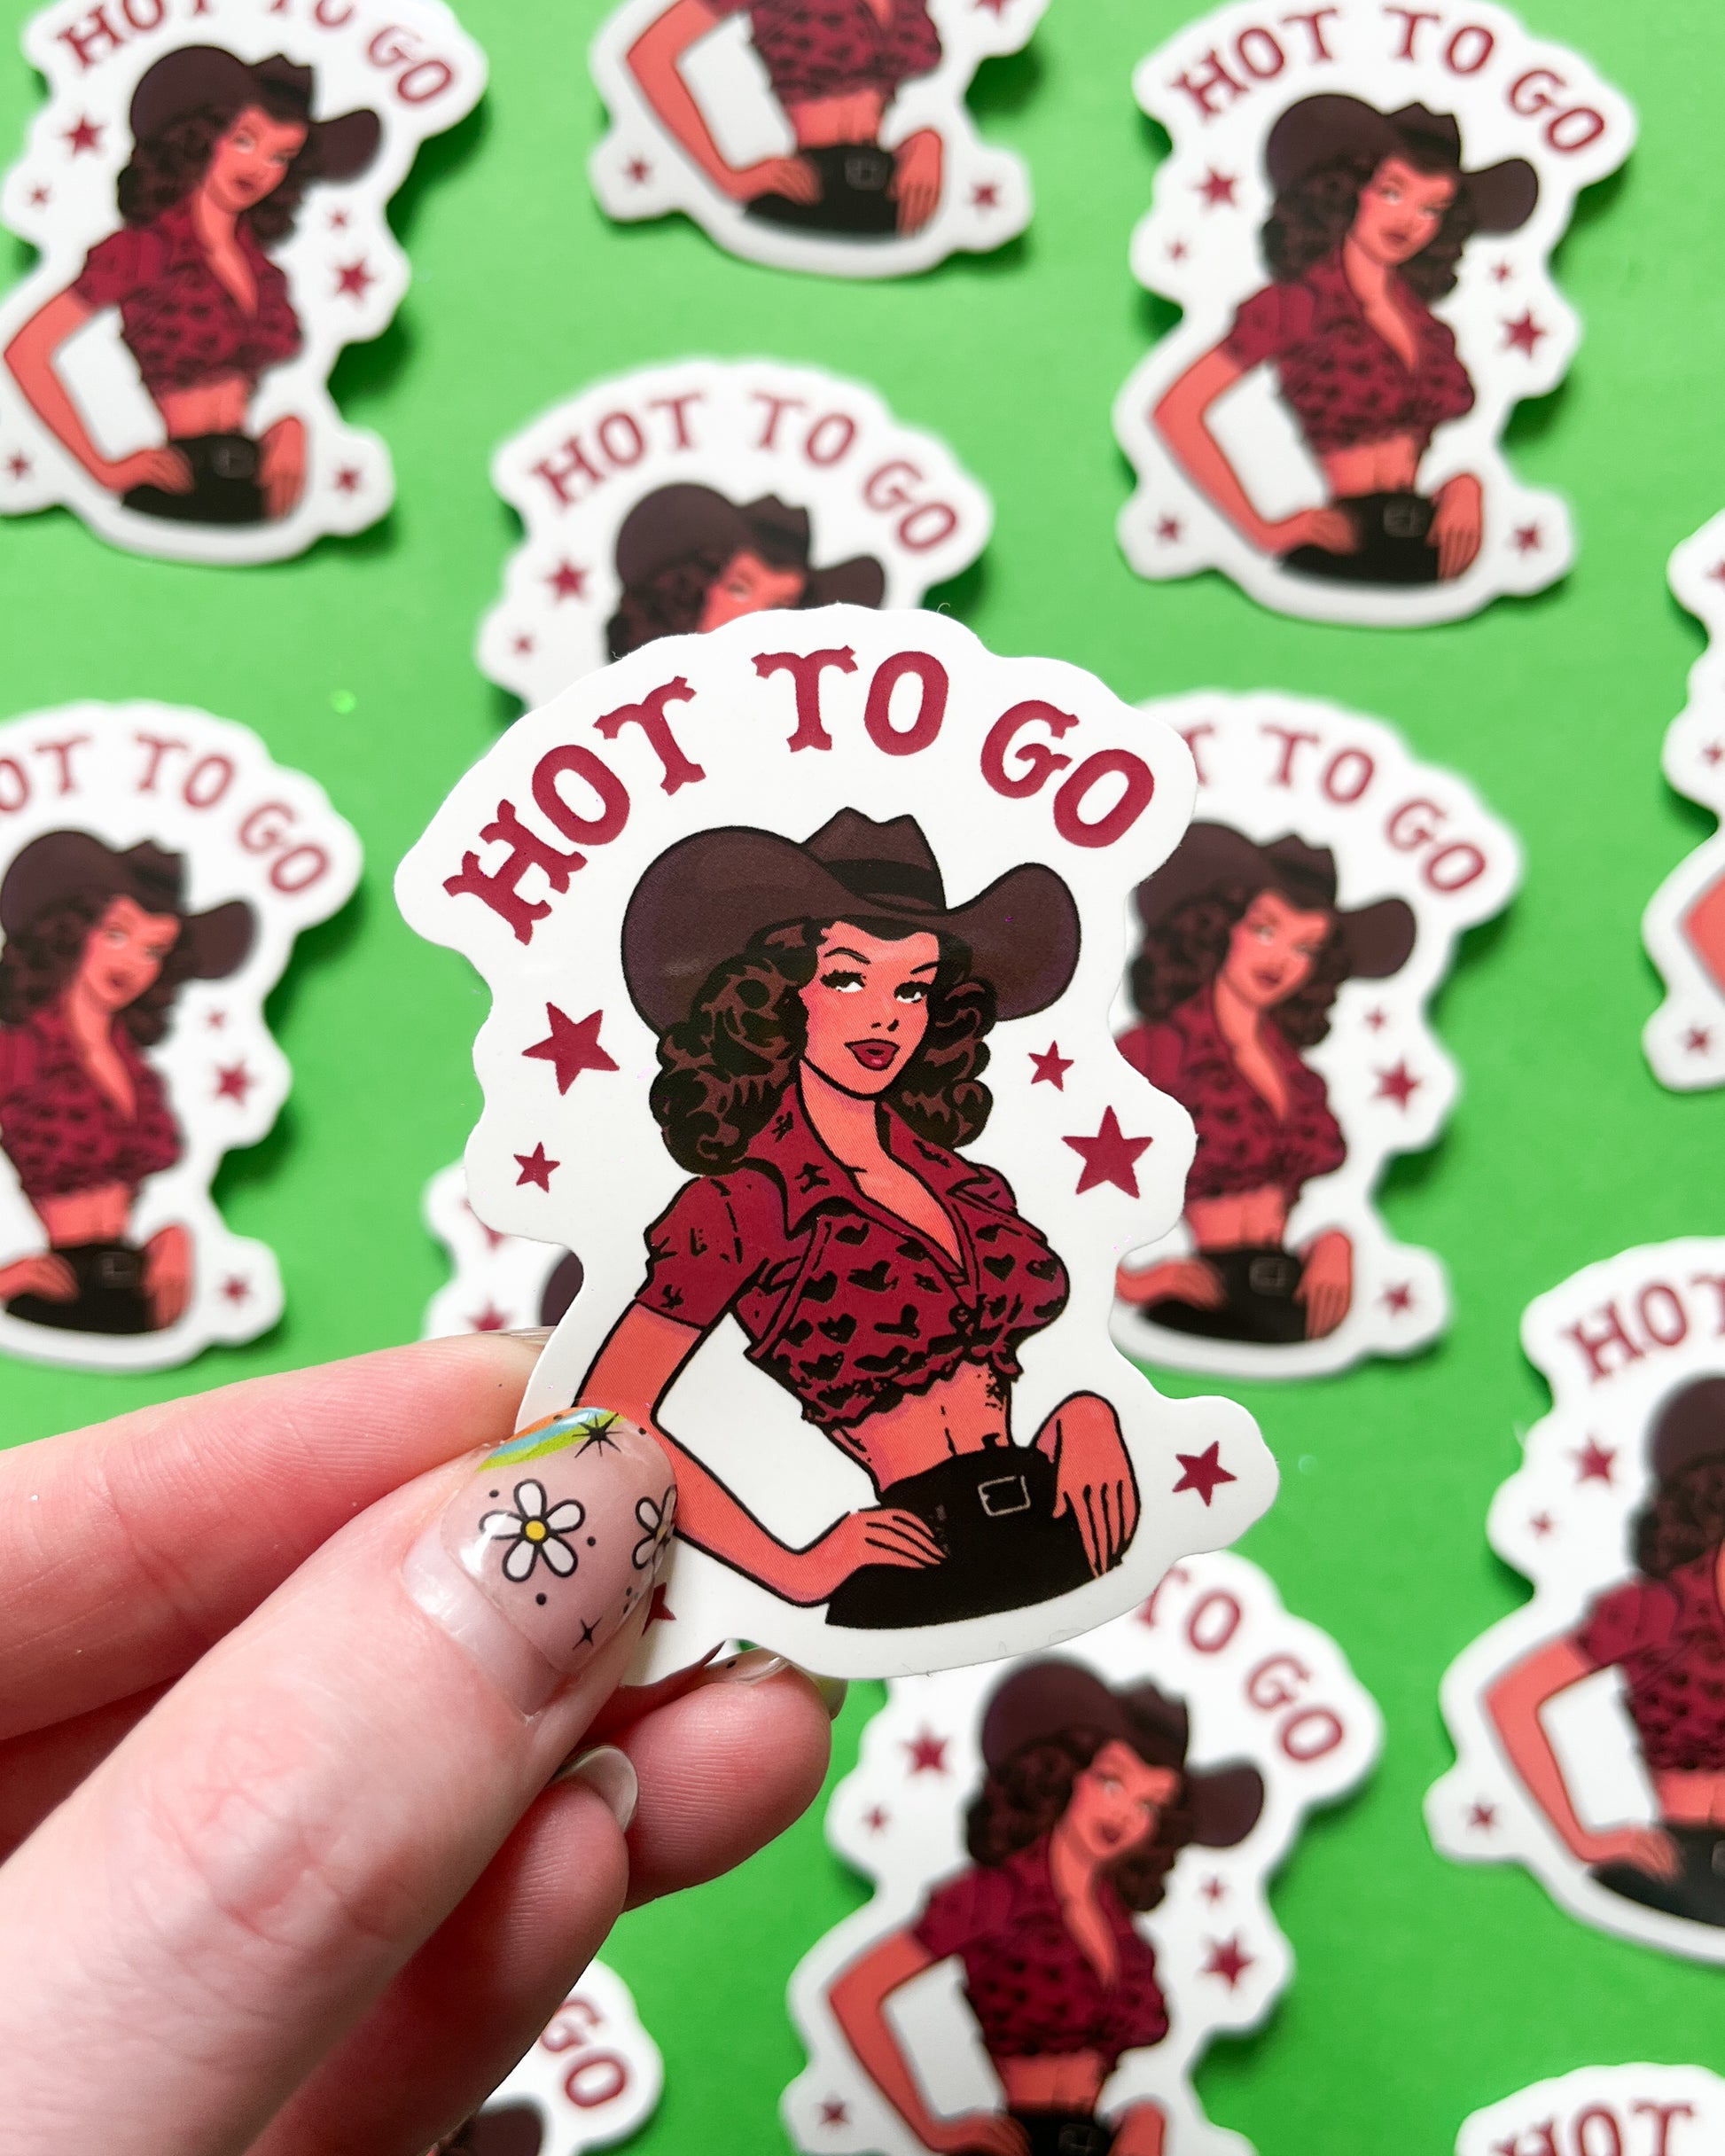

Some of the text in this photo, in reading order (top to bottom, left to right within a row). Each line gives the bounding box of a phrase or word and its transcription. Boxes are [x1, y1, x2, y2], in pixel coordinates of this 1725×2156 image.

[57, 0, 213, 71] HO
[367, 24, 452, 103] GO
[1172, 8, 1605, 152] HOT TO GO
[531, 392, 958, 551] HOT TO GO
[0, 734, 331, 894] OT TO GO
[443, 676, 707, 946] HOT
[751, 644, 949, 756] TO
[980, 699, 1155, 848] GO
[1261, 724, 1376, 805] TO
[1386, 798, 1487, 894] GO
[1246, 1652, 1344, 1762] GO
[540, 1997, 628, 2110] GO
